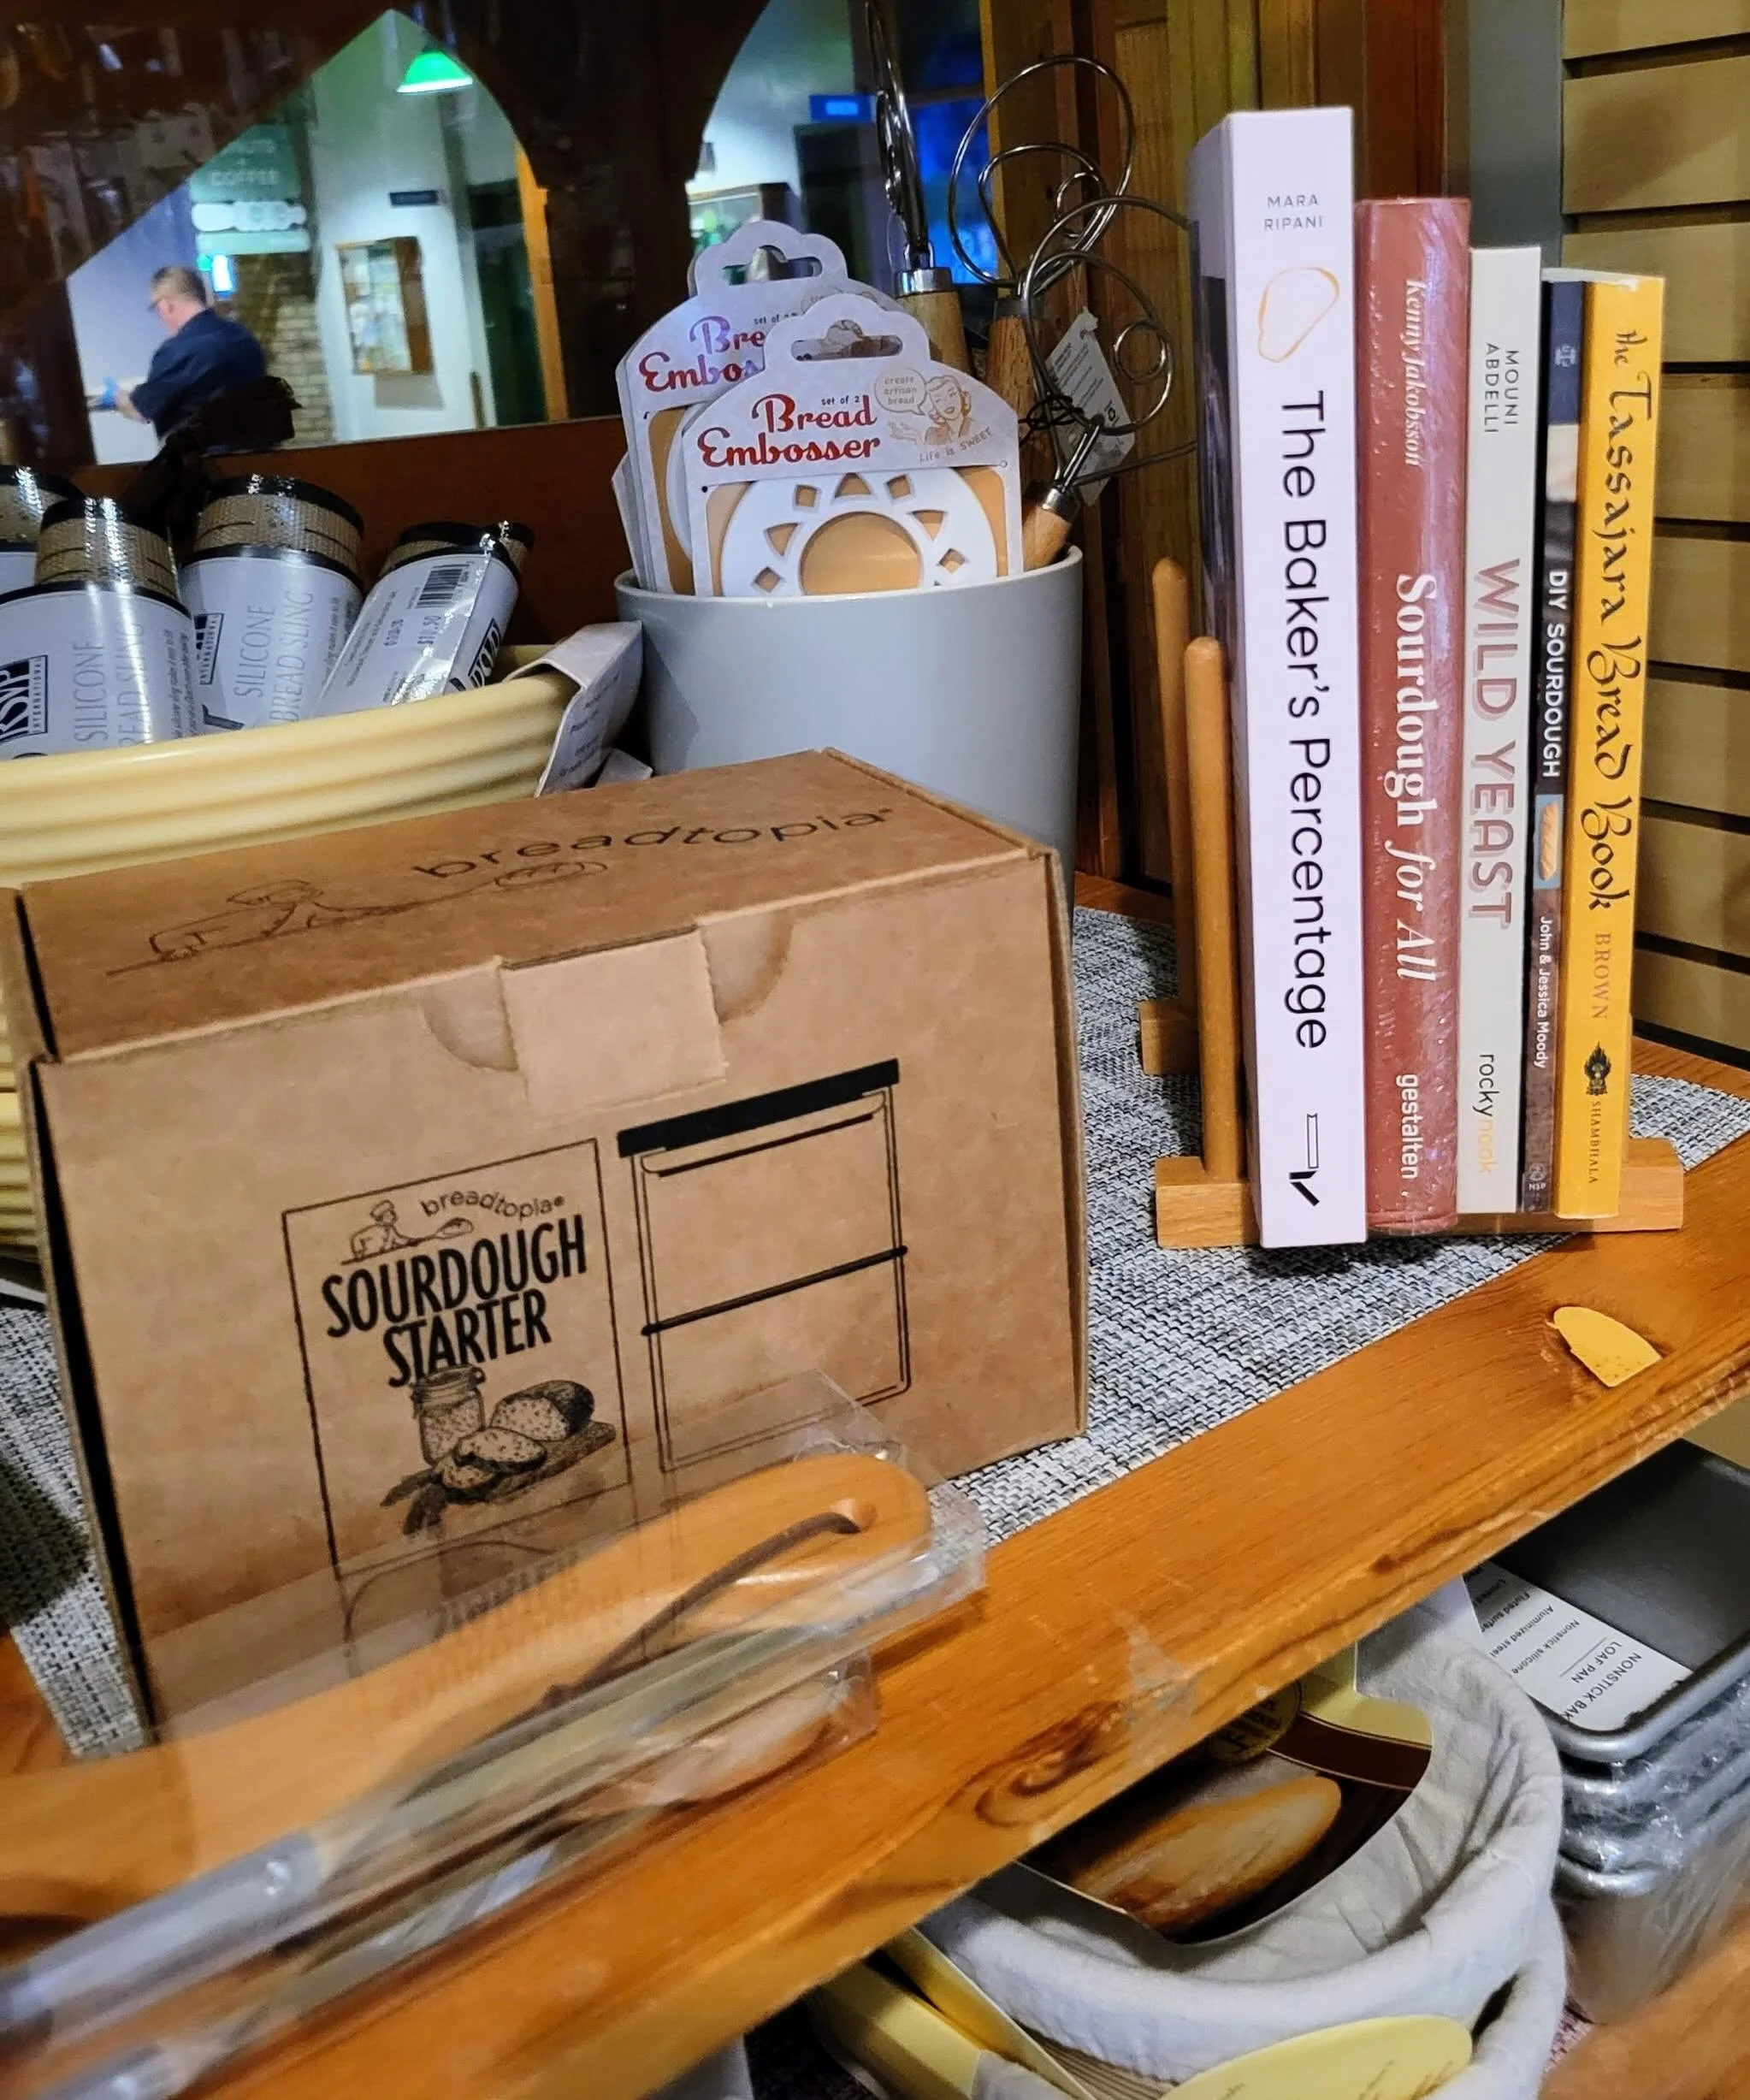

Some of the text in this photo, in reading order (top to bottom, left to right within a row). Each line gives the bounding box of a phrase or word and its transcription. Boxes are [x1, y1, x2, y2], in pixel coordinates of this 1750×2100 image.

[1263, 216, 1324, 232] RIPANI
[1267, 193, 1319, 210] MARA
[638, 351, 766, 393] Embos
[689, 314, 766, 356] Bre
[752, 393, 878, 433] Bread
[821, 394, 861, 406] set of 2
[1399, 347, 1427, 469] Jakobsson
[1484, 342, 1499, 434] ABDELLI
[1504, 349, 1520, 426] MOUNI
[697, 426, 881, 468] Embosser
[234, 604, 275, 698] SILICONE
[269, 590, 313, 722] BREAD SLING
[1581, 328, 1652, 910] the Tassajara Bread Book
[1542, 571, 1567, 778] DIY SOURDOUGH
[1280, 390, 1332, 1049] The Baker's Percentage
[1466, 558, 1521, 929] WILD YEAST
[1384, 573, 1438, 982] Sourdough for All
[1534, 916, 1552, 1068] John & Jessica Moody
[1591, 932, 1611, 1020] BROWN
[1395, 1074, 1424, 1180] gestalten
[1587, 1100, 1599, 1184] SHAMBHALA
[321, 1213, 588, 1338] SOURDOUGH
[383, 1288, 553, 1387] STARTER
[1511, 1604, 1554, 1642] Aluminized
[1511, 1619, 1581, 1675] Nonstick silicone
[1570, 1641, 1623, 1684] LOAF PAN
[1587, 1652, 1642, 1703] NONSTICK
